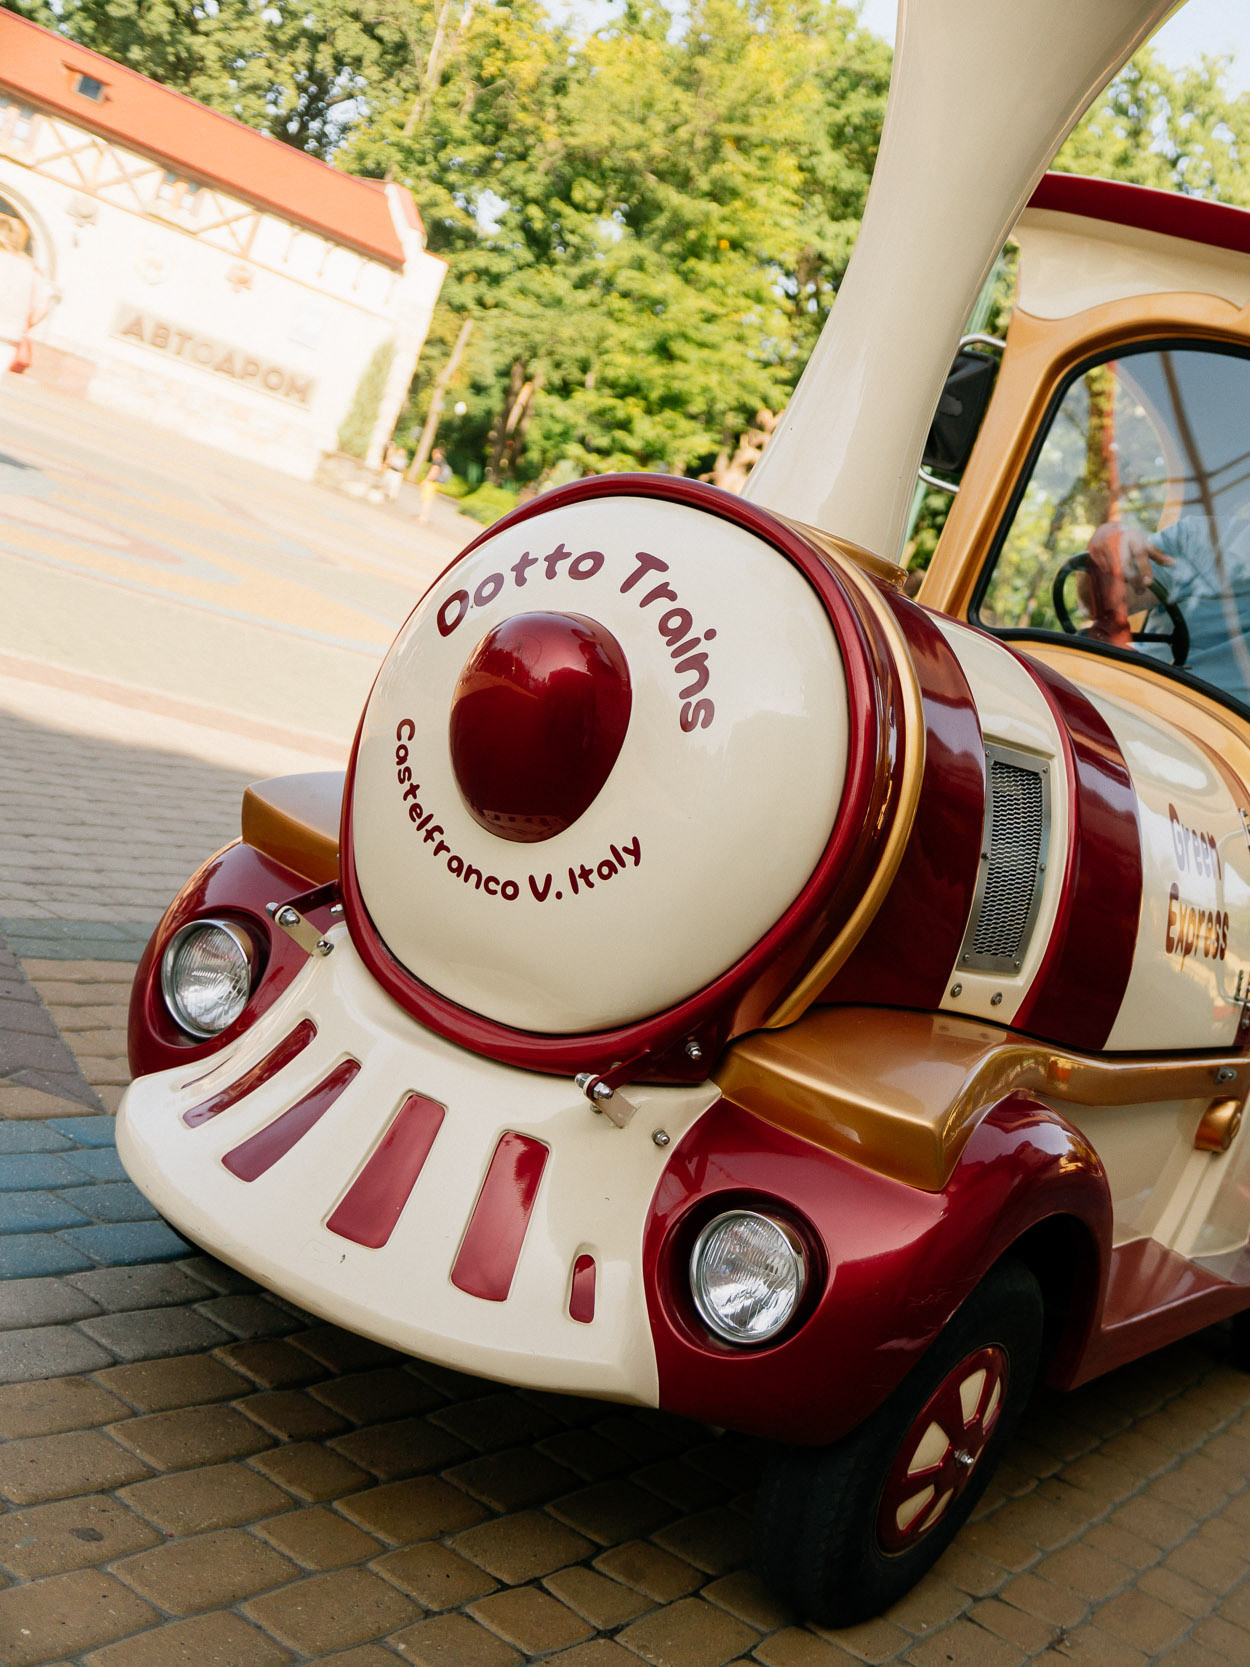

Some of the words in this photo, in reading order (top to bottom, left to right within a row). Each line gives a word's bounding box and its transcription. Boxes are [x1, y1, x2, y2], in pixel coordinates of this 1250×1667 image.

[121, 315, 314, 402] АВТОДРОМ
[436, 543, 605, 638] Dotto
[620, 551, 717, 733] Trains
[395, 718, 520, 901] Castelfranco
[528, 873, 563, 902] V.
[569, 836, 642, 895] Italy
[1168, 803, 1222, 880] Green
[1165, 882, 1229, 970] Express
